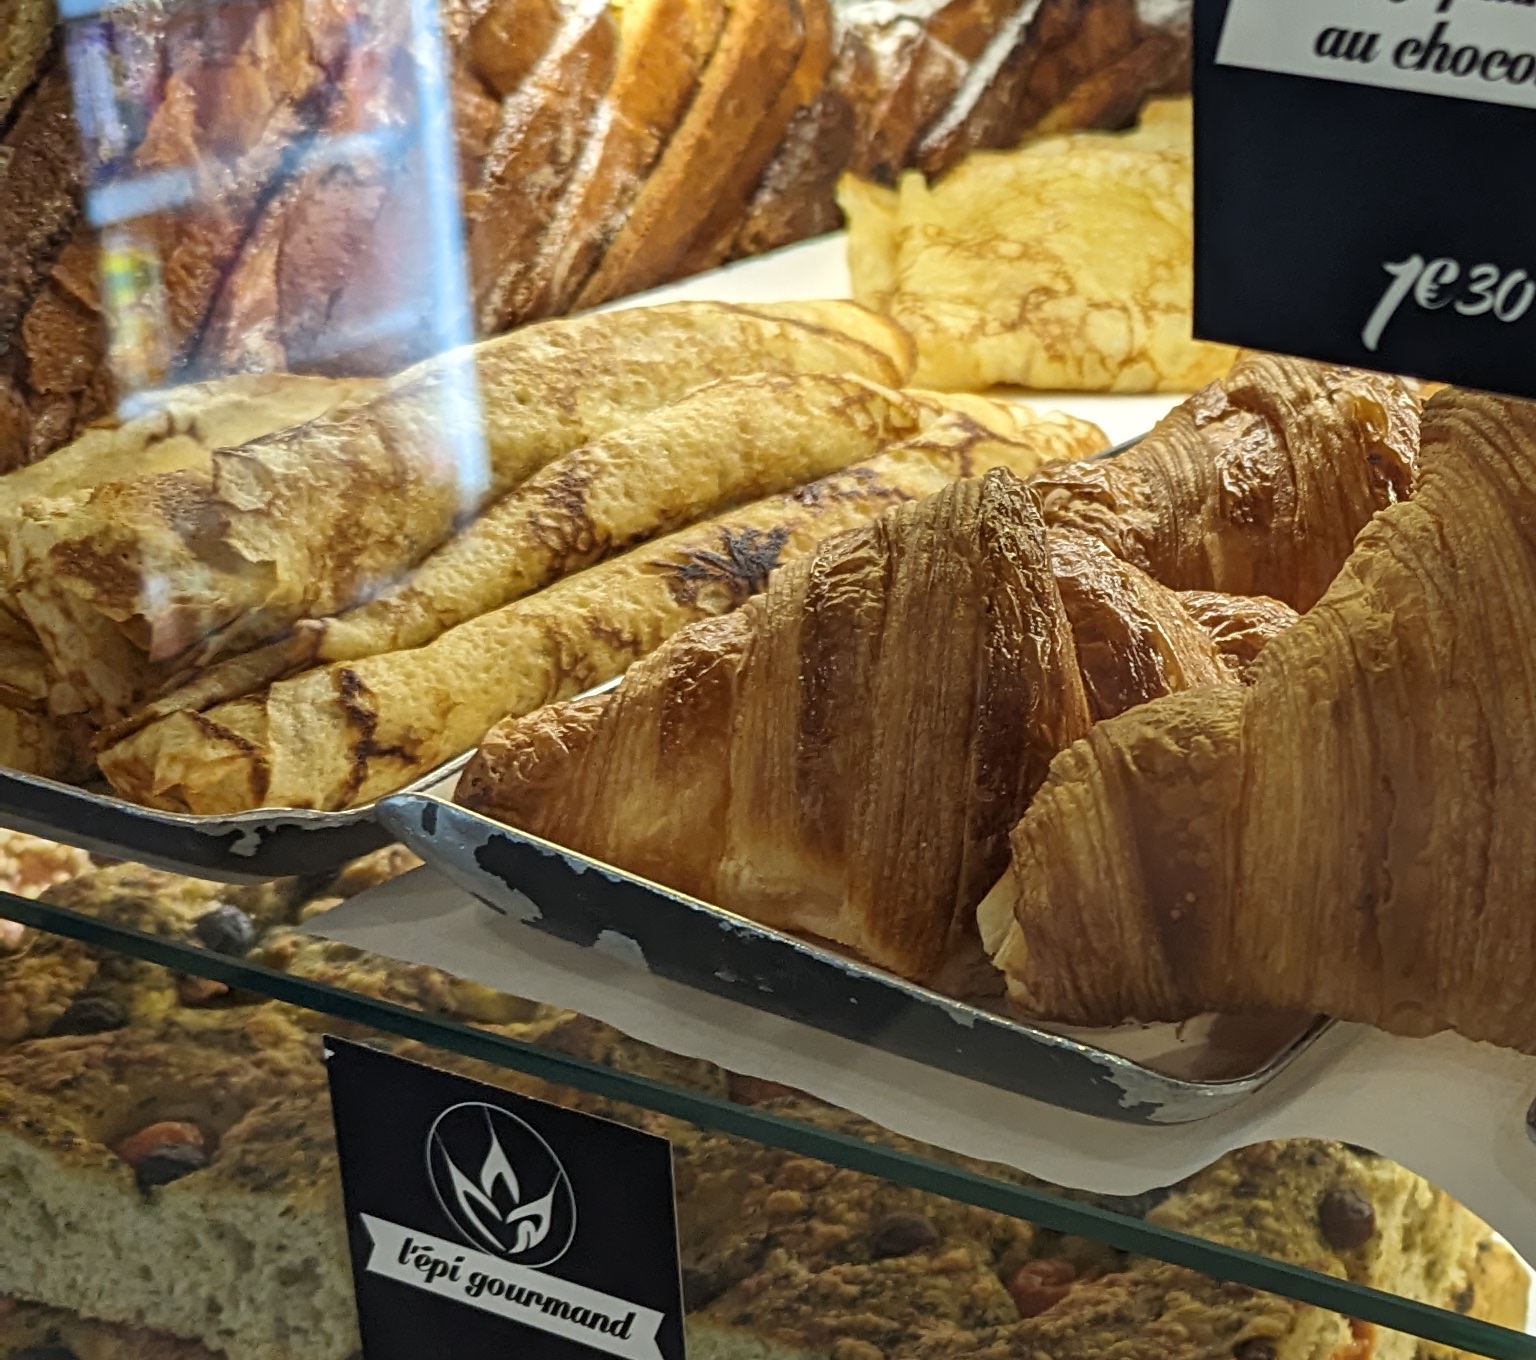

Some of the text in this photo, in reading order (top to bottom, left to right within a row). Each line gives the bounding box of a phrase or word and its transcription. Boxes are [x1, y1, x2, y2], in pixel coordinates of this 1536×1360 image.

[1313, 26, 1381, 64] au
[397, 1236, 636, 1340] l'épi gourmand
